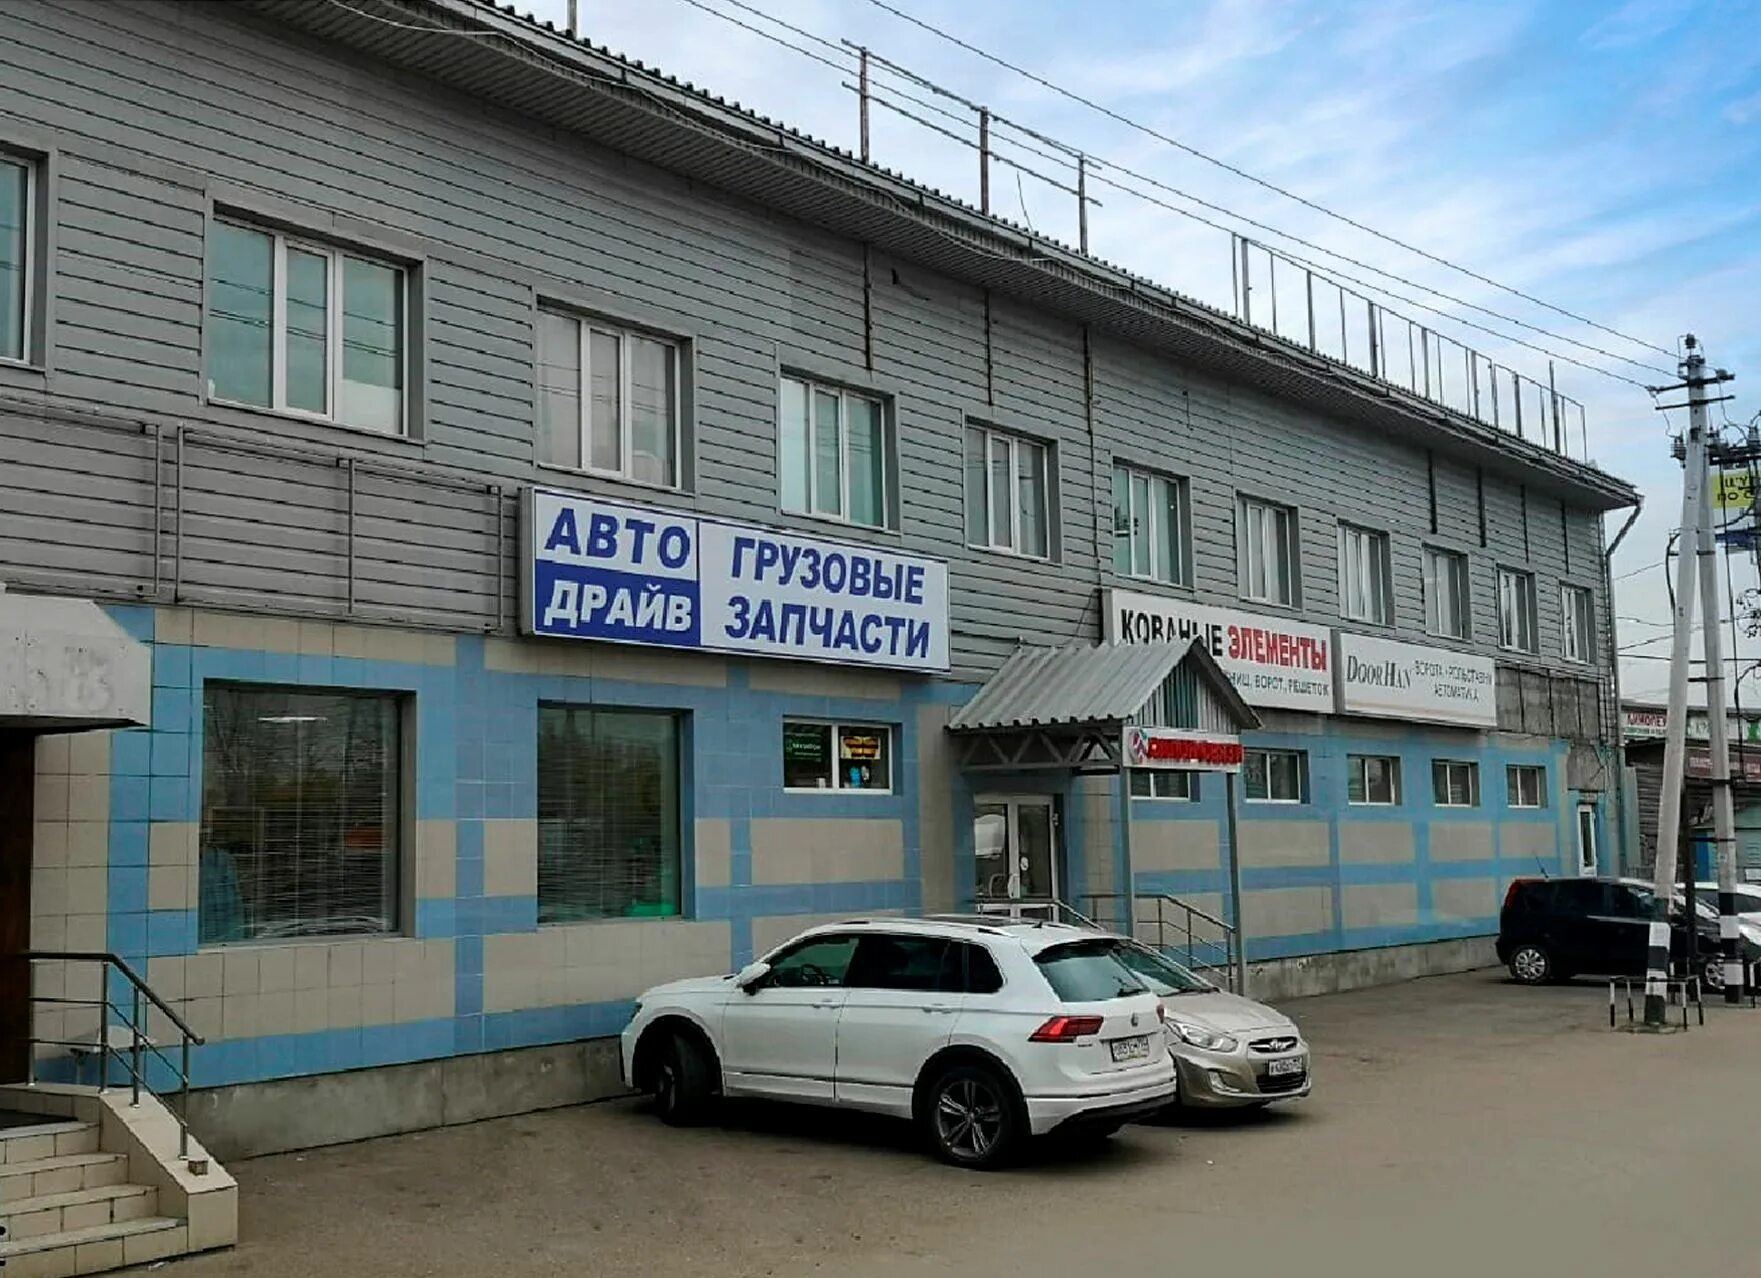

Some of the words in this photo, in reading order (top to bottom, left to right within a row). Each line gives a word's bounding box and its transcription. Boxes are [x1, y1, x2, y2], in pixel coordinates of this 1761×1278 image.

[544, 507, 691, 569] АВТО
[730, 535, 925, 605] ГРУЗОВЫЕ
[543, 579, 692, 631] ДРАЙВ
[724, 595, 930, 659] ЗАПЧАСТИ
[1227, 624, 1327, 672] ЭЛЕМЕНТЫ
